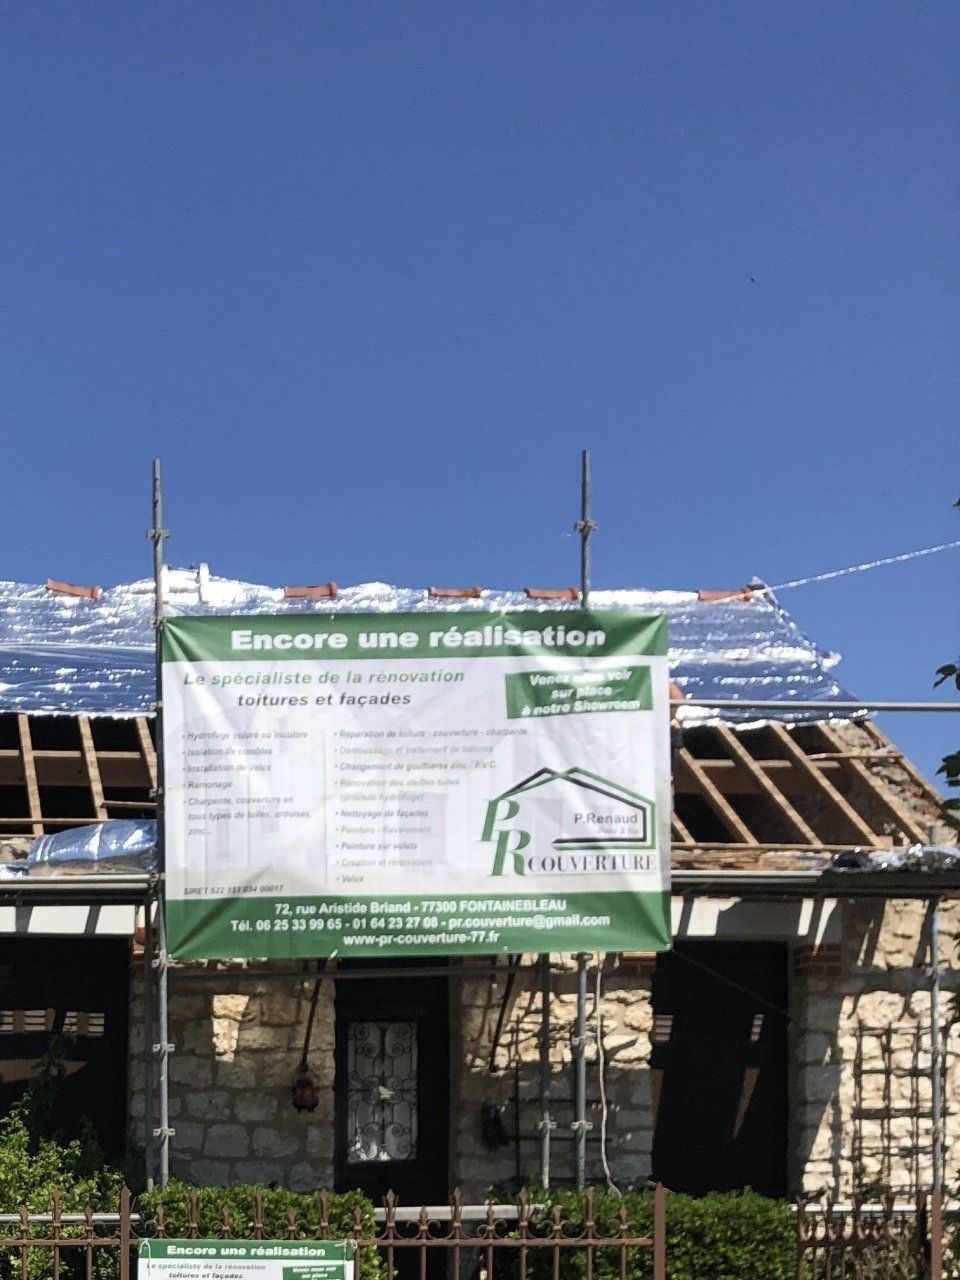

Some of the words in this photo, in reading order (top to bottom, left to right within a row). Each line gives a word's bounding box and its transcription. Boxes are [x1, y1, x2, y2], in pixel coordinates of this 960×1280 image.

[231, 630, 348, 650] Encore
[358, 631, 419, 649] une
[429, 626, 606, 648] réalisation
[184, 672, 205, 686] Le
[212, 670, 312, 687] spécialiste
[318, 671, 340, 684] de
[346, 671, 362, 684] la
[368, 669, 464, 684] rénovation
[238, 693, 308, 707] toitures
[315, 693, 332, 706] et
[339, 691, 412, 708] façades
[528, 854, 657, 873] COUVERTURE
[296, 905, 316, 915] rue
[319, 902, 367, 915] Aristide
[370, 901, 411, 914] Briand
[459, 899, 567, 912] FONTAINEBLEAU
[230, 919, 253, 932] Tél.
[448, 913, 610, 930] pr.couverture@gmail.com
[167, 1245, 217, 1255] Encore
[220, 1247, 247, 1255] une
[251, 1246, 326, 1257] réalisation
